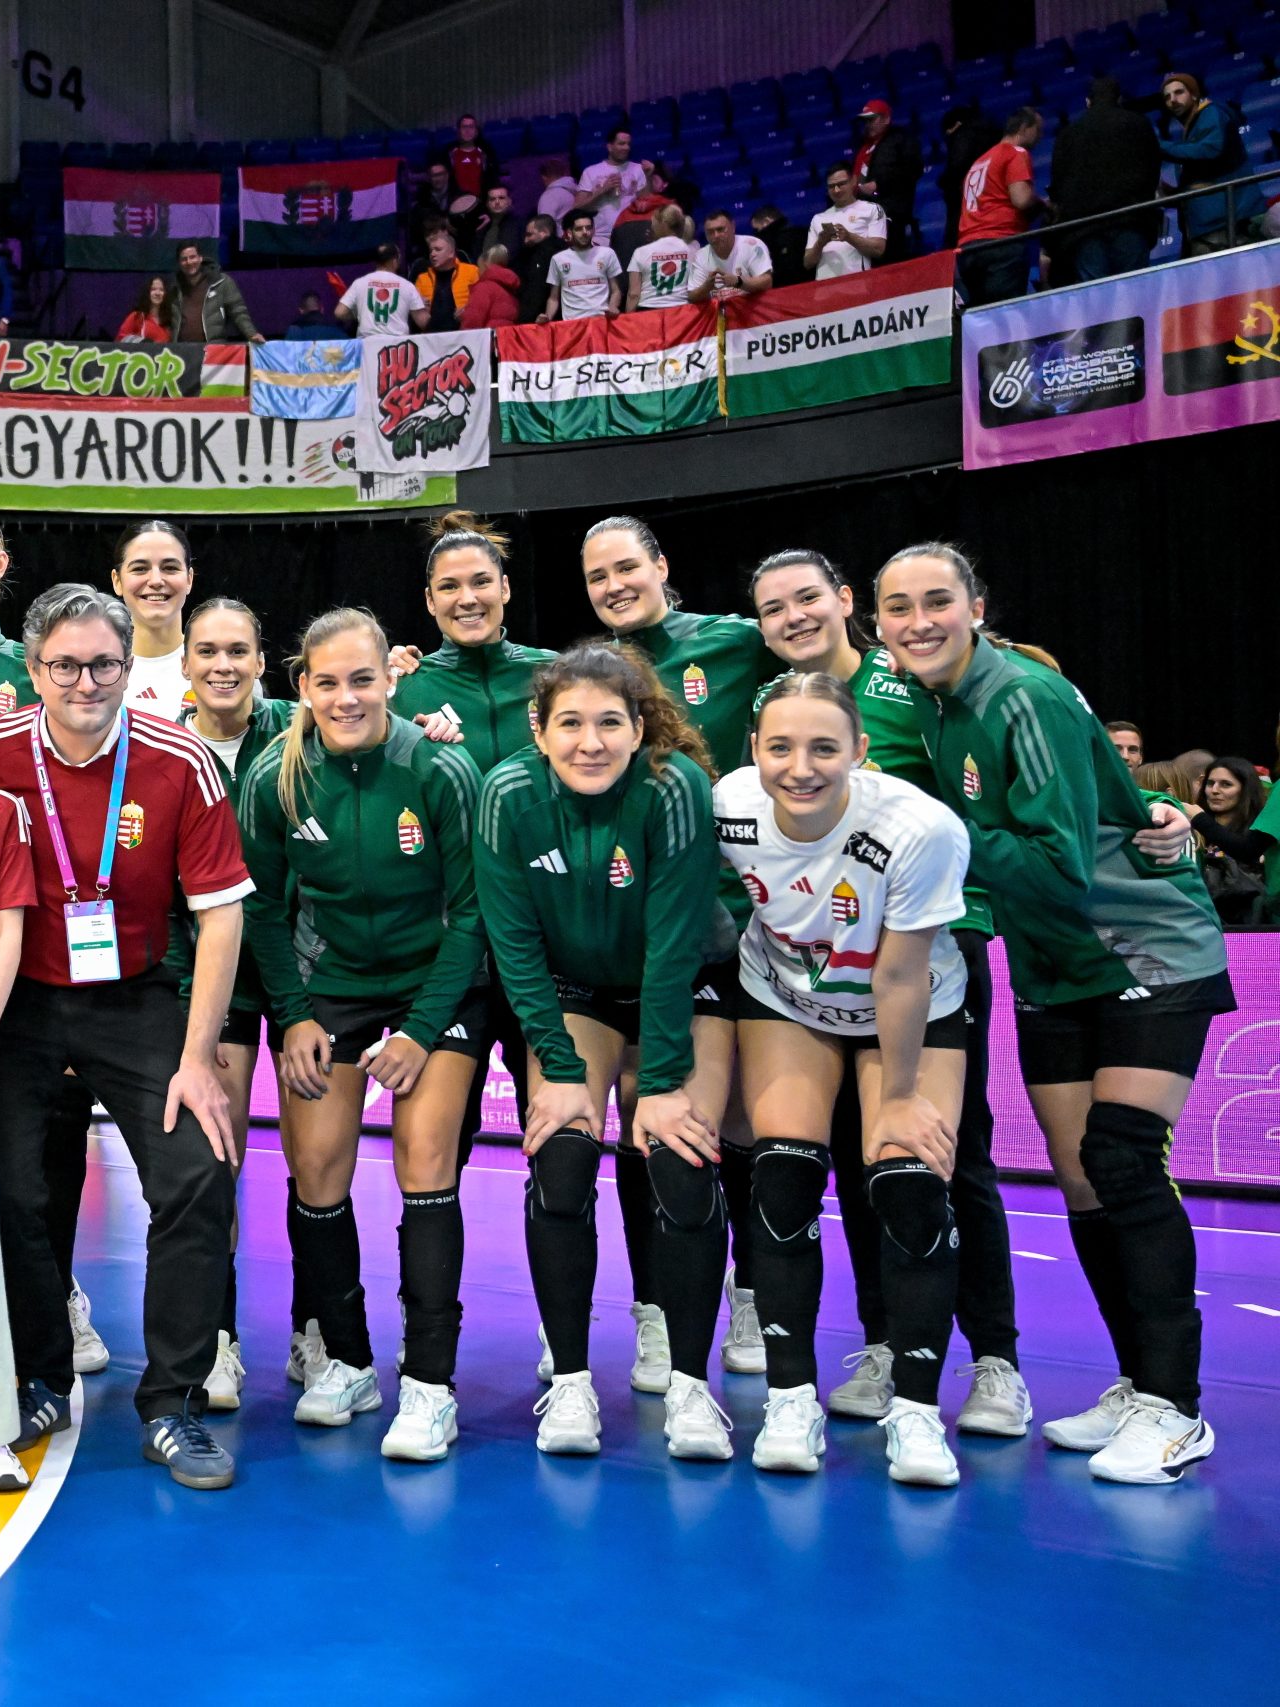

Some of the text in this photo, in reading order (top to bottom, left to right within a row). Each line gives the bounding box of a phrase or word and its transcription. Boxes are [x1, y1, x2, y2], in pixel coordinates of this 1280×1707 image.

[22, 50, 86, 112] G4
[747, 304, 930, 360] PÜSPÖKLADÁNY
[378, 340, 420, 394] HU
[1042, 353, 1135, 376] HANDBALL
[1043, 361, 1135, 387] WORLD
[378, 345, 473, 438] SECTOR
[1043, 372, 1135, 395] CHAMPIONSHIP
[721, 824, 756, 839] JYSK
[856, 839, 888, 869] YSK
